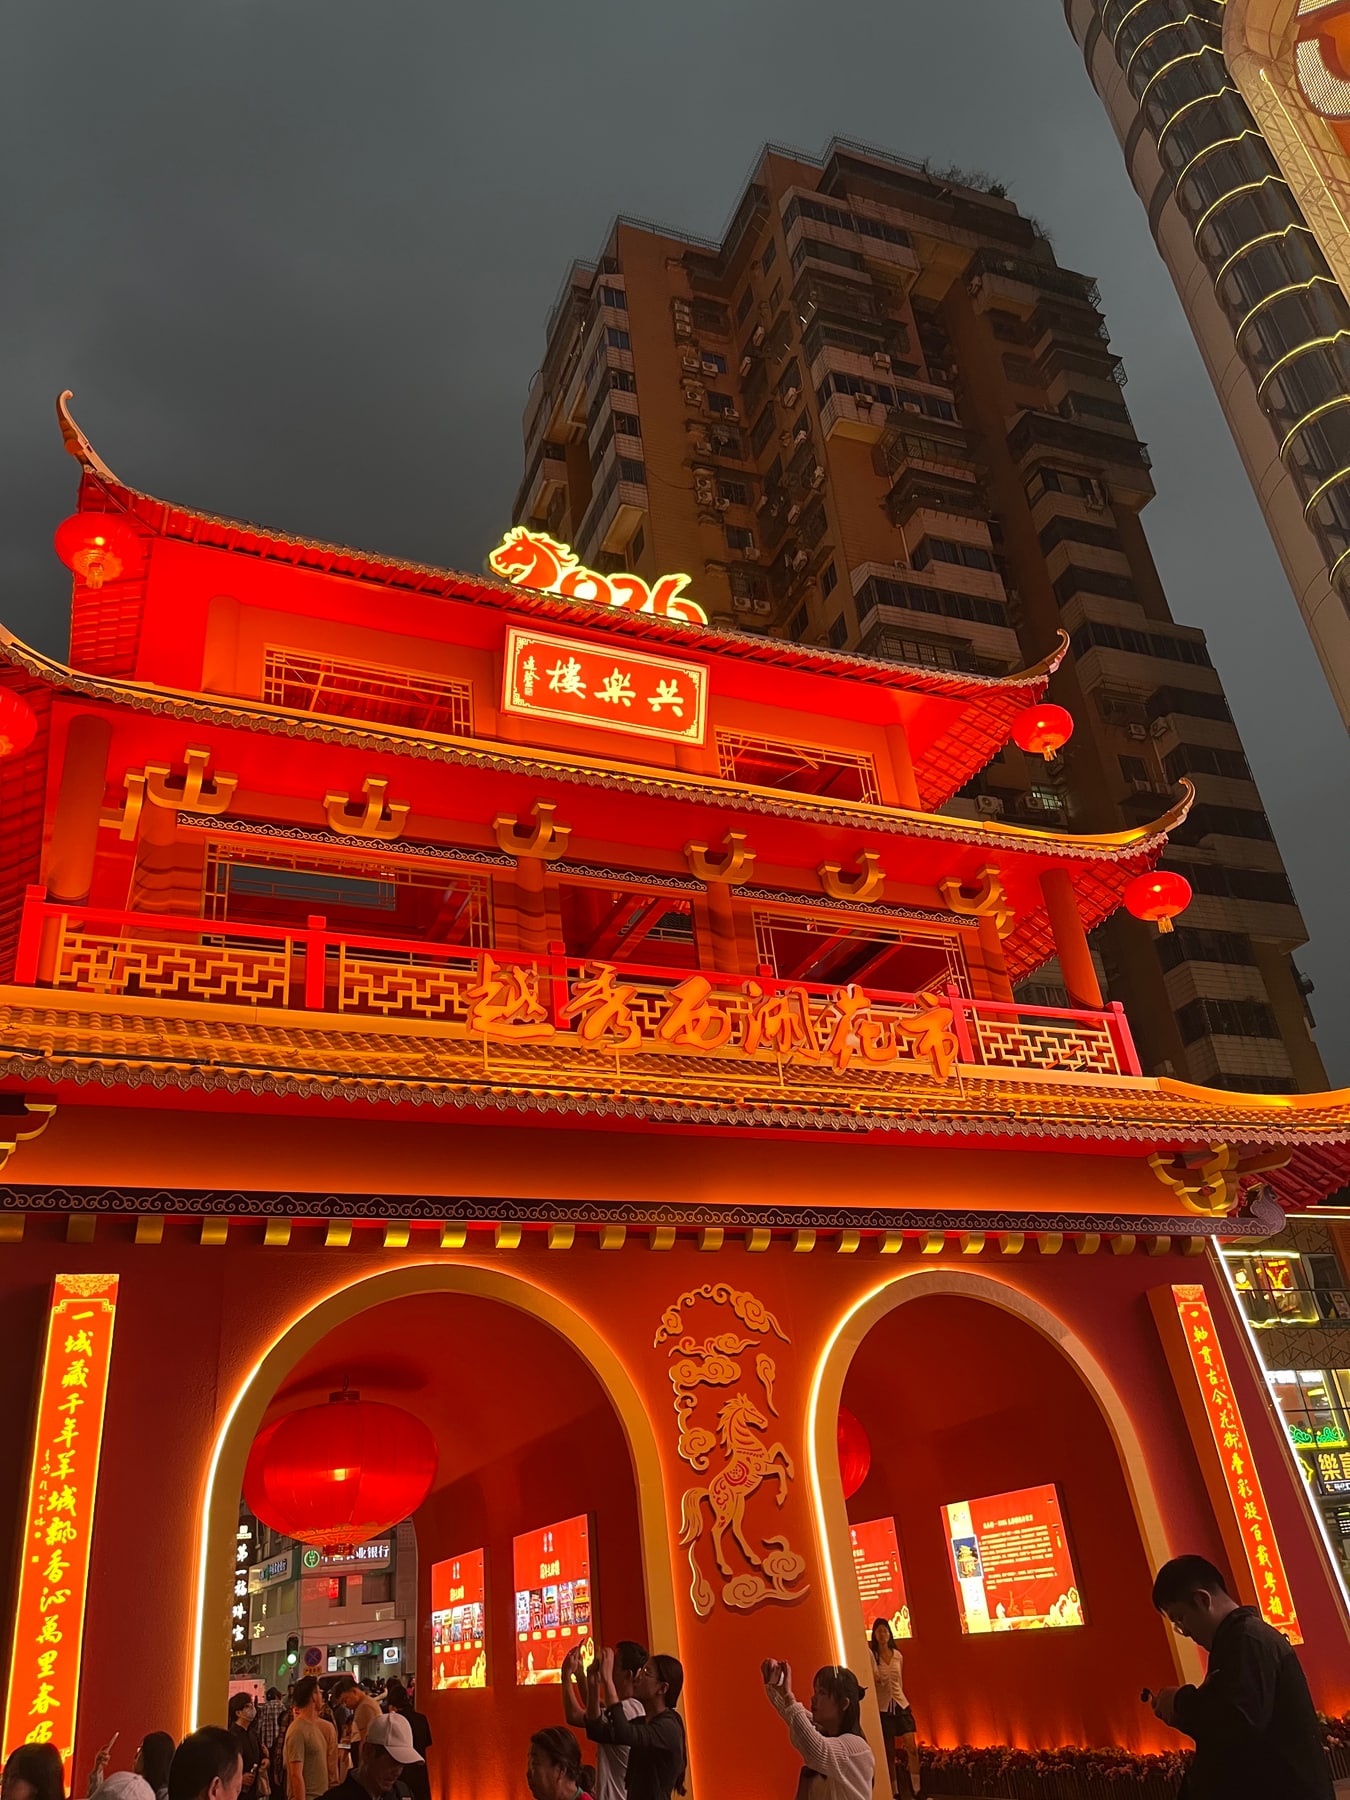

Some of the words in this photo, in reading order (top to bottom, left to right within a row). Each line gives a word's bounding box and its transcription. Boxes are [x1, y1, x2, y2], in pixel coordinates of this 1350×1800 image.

[465, 952, 957, 1084] 越秀西湖花市
